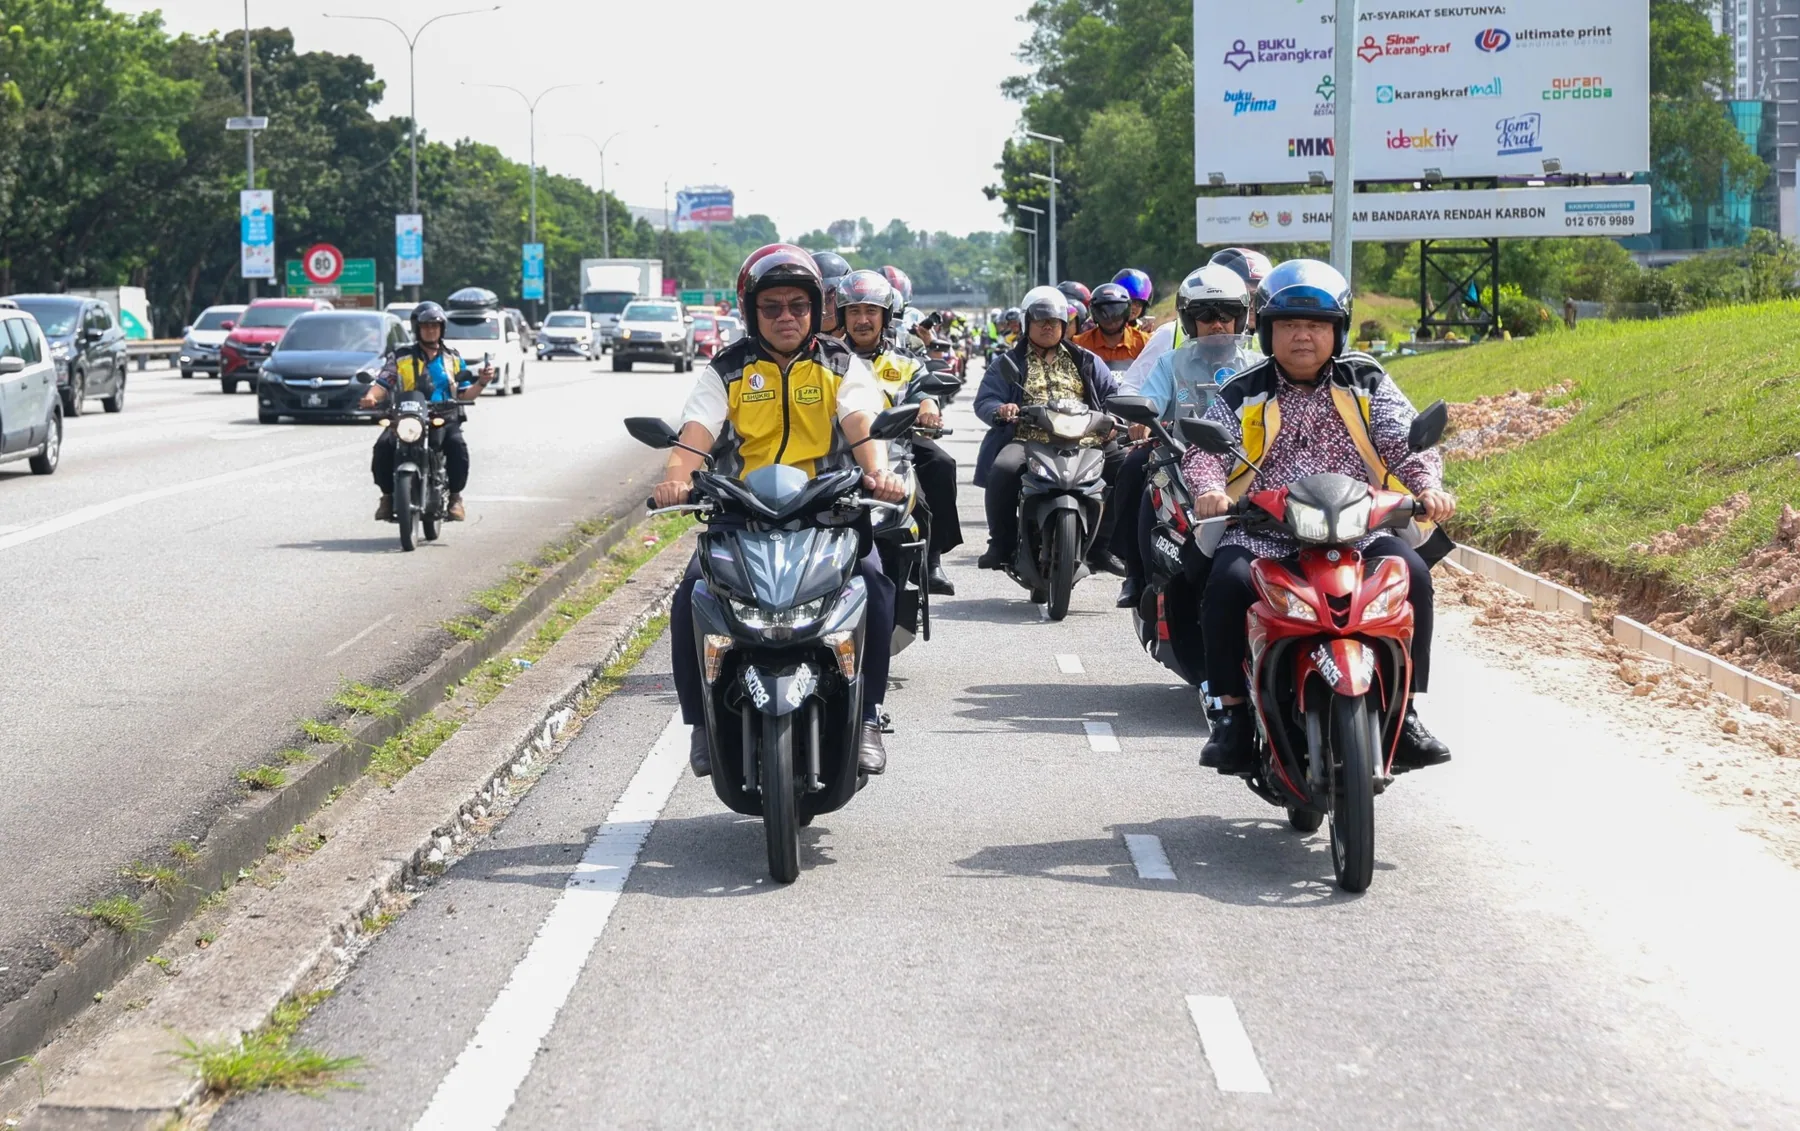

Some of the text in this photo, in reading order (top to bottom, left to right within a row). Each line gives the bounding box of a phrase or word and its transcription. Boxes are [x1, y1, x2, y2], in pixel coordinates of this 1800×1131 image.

[1434, 5, 1506, 18] SEKUTUNYA:
[1386, 34, 1420, 46] Sinar
[1515, 26, 1612, 41] ultimate print
[1258, 38, 1296, 51] BUKU
[1386, 42, 1451, 56] karangkraf
[1258, 47, 1334, 64] karangkraf
[1552, 76, 1602, 90] quran
[1224, 89, 1252, 103] buku
[1542, 87, 1613, 100] cordoba
[1234, 97, 1277, 116] prima
[1495, 116, 1531, 133] Tom
[1386, 128, 1459, 149] ideaktiv
[1497, 131, 1536, 148] Kraf
[1302, 207, 1546, 224] SHAH AM BANDARAYA RENDAH KARBON
[1565, 215, 1635, 227] 012 676 9989
[314, 256, 331, 270] 80
